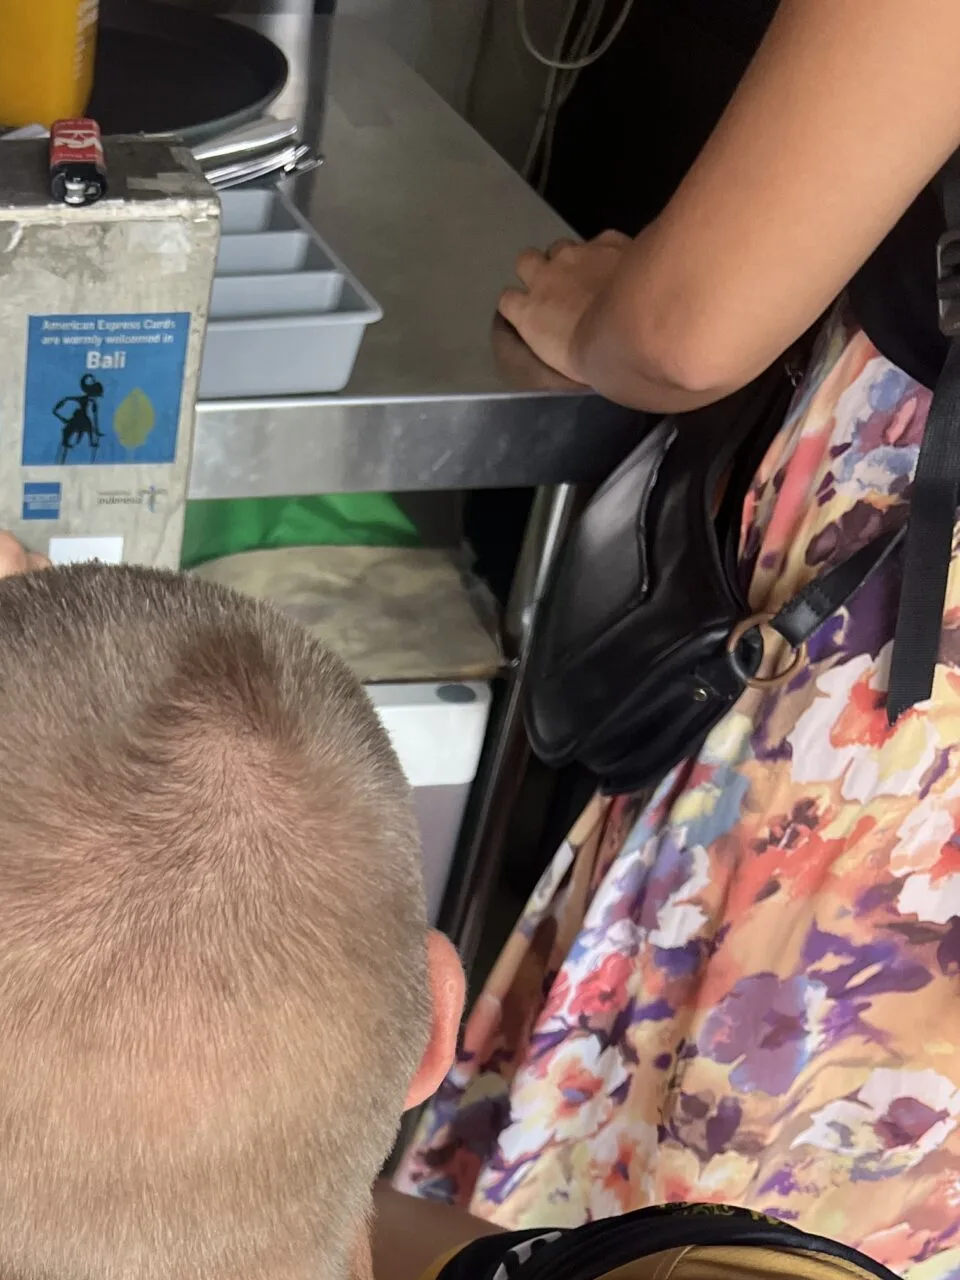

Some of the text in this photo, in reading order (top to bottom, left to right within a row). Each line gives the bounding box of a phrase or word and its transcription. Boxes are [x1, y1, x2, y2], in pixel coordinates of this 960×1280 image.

[42, 318, 176, 332] American Express Cards
[41, 333, 174, 347] are warmly welcomed in
[86, 350, 127, 369] Bali
